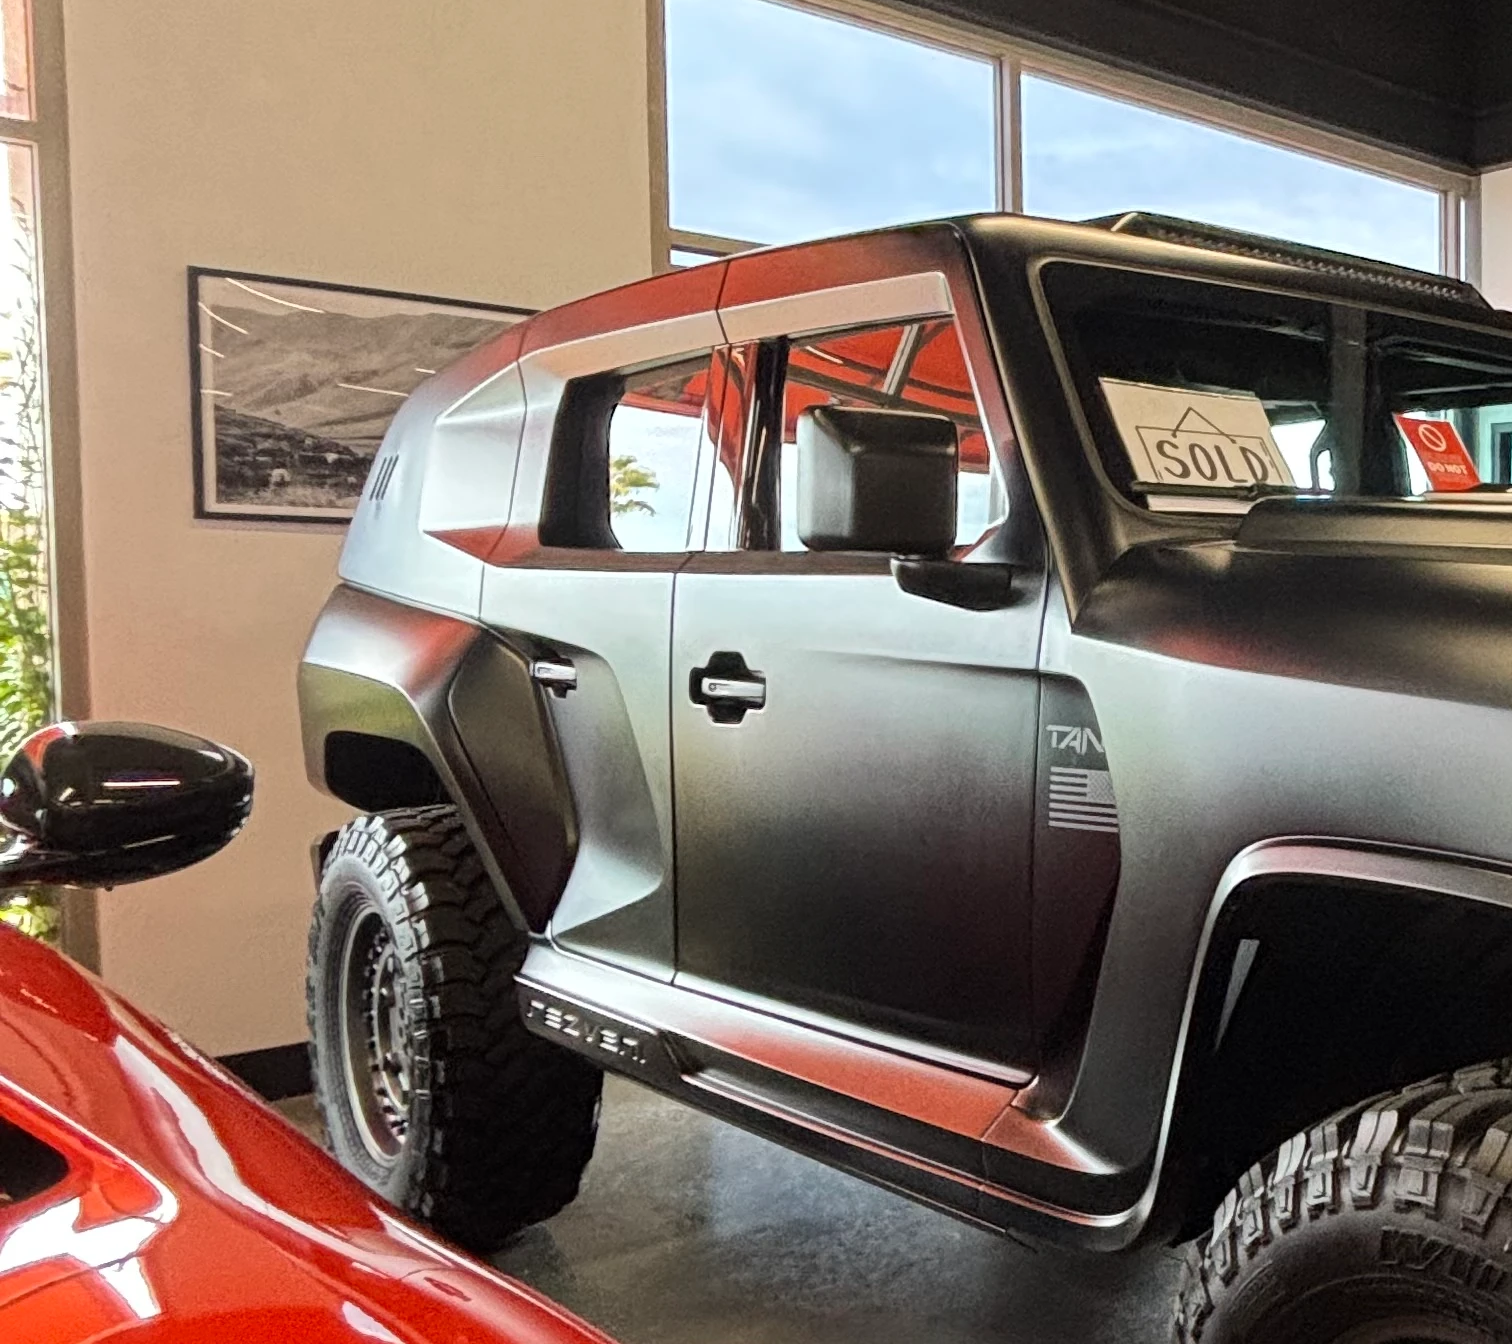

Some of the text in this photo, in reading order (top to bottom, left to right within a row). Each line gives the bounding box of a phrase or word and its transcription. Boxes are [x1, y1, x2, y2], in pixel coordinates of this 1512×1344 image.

[1155, 439, 1270, 484] SOLD
[1426, 461, 1468, 475] DO NOT
